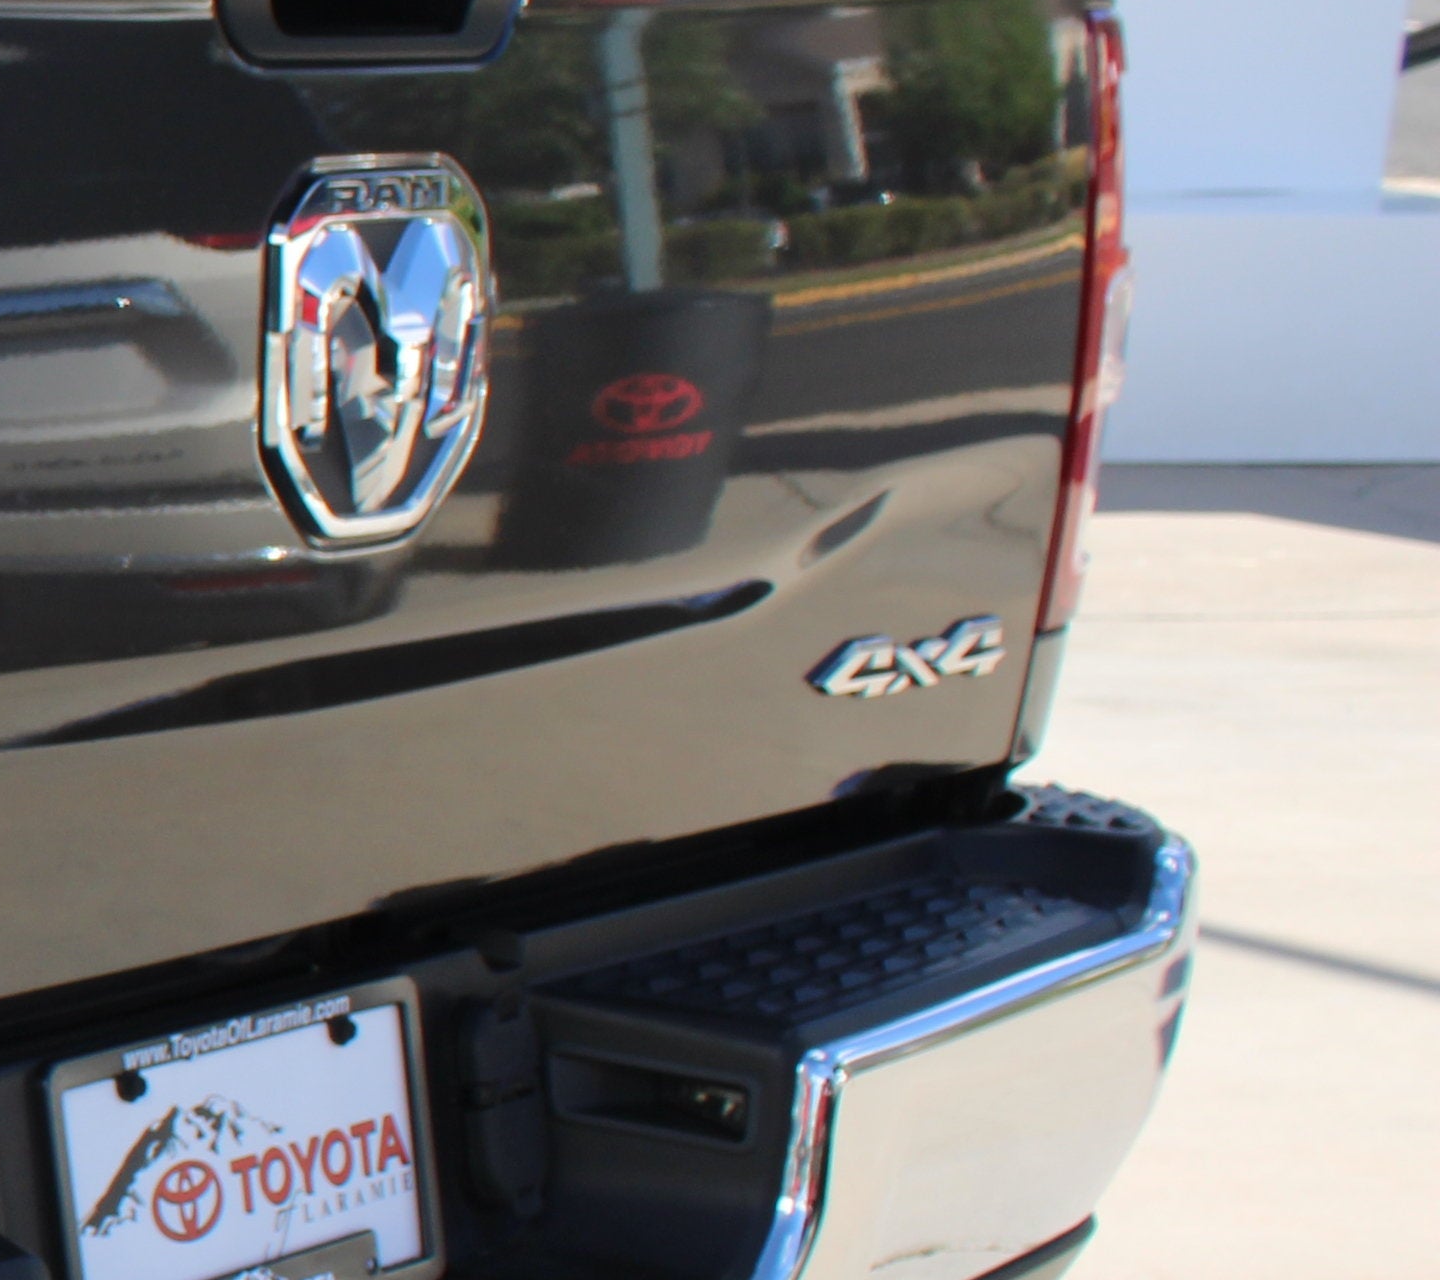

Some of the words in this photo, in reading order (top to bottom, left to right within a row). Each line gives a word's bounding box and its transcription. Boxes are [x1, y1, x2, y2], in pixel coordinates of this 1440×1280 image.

[327, 177, 450, 214] RAM
[230, 1114, 410, 1214] TOYOTA
[302, 1170, 414, 1223] LARAMIE
